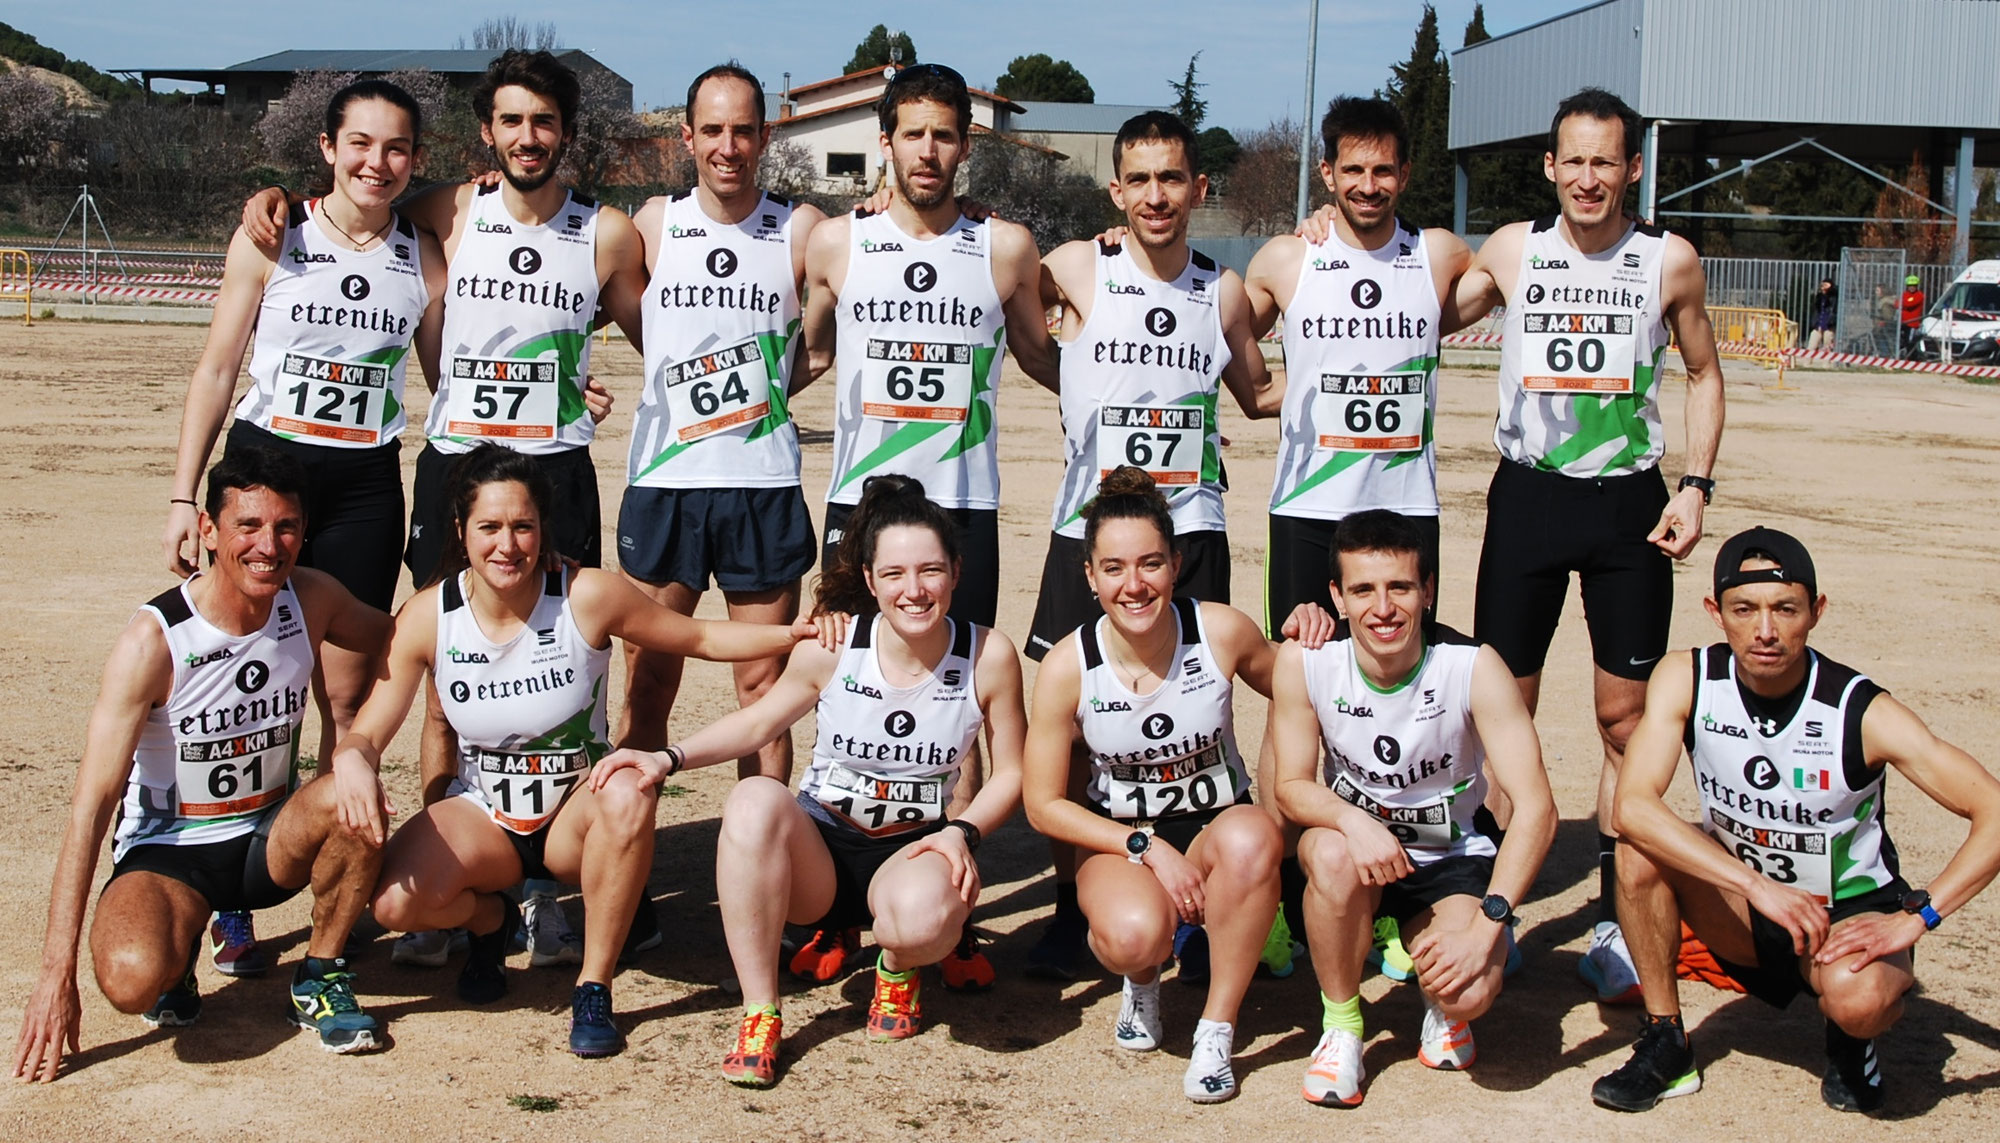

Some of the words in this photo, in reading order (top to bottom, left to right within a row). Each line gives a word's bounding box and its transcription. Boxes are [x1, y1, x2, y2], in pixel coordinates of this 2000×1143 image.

[478, 224, 512, 234] LUGA
[672, 228, 707, 238] LUGA
[294, 253, 336, 263] LUGA
[865, 242, 904, 253] LUGA
[956, 242, 982, 250] SEAT
[1316, 260, 1350, 271] LUGA
[1533, 260, 1569, 269] LUGA
[1616, 269, 1645, 277] SEAT
[457, 274, 585, 314] etxenike
[661, 282, 780, 315] etxenike
[1109, 285, 1145, 295] LUGA
[1552, 285, 1645, 310] etxenike
[291, 302, 408, 335] etxenike
[853, 297, 983, 329] etxenike
[1302, 312, 1428, 339] etxenike
[1547, 315, 1607, 333] A4XKM
[683, 348, 739, 381] A4XKM
[888, 342, 947, 362] A4XKM
[1095, 338, 1212, 376] etxenike
[1546, 338, 1605, 372] 60
[306, 360, 364, 384] A4XKM
[474, 362, 530, 380] A4XKM
[690, 371, 750, 416] 64
[886, 366, 945, 403] 65
[1345, 377, 1402, 393] A4XKM
[288, 381, 369, 425] 121
[472, 384, 529, 420] 57
[1127, 409, 1183, 427] A4XKM
[1345, 399, 1401, 433] 66
[1126, 432, 1182, 467] 67
[278, 622, 298, 632] SEAT
[190, 648, 234, 668] LUGA
[452, 653, 489, 664] LUGA
[533, 645, 564, 657] SEAT
[477, 667, 575, 700] etxenike
[845, 681, 883, 700] LUGA
[1183, 673, 1209, 686] SEAT
[179, 686, 307, 736] etxenike
[1094, 701, 1132, 713] LUGA
[1338, 703, 1373, 717] LUGA
[1704, 720, 1748, 739] LUGA
[209, 732, 268, 760] A4XKM
[833, 733, 958, 766] etxenike
[208, 756, 262, 799] 61
[505, 756, 565, 774] A4XKM
[1138, 760, 1196, 782] A4XKM
[493, 775, 580, 814] 117
[852, 775, 913, 801] A4XKM
[1126, 774, 1218, 818] 120
[1700, 772, 1834, 826] etxenike
[1357, 795, 1418, 822] A4XKM
[1733, 822, 1797, 851] A4XKM
[1736, 842, 1798, 884] 63
